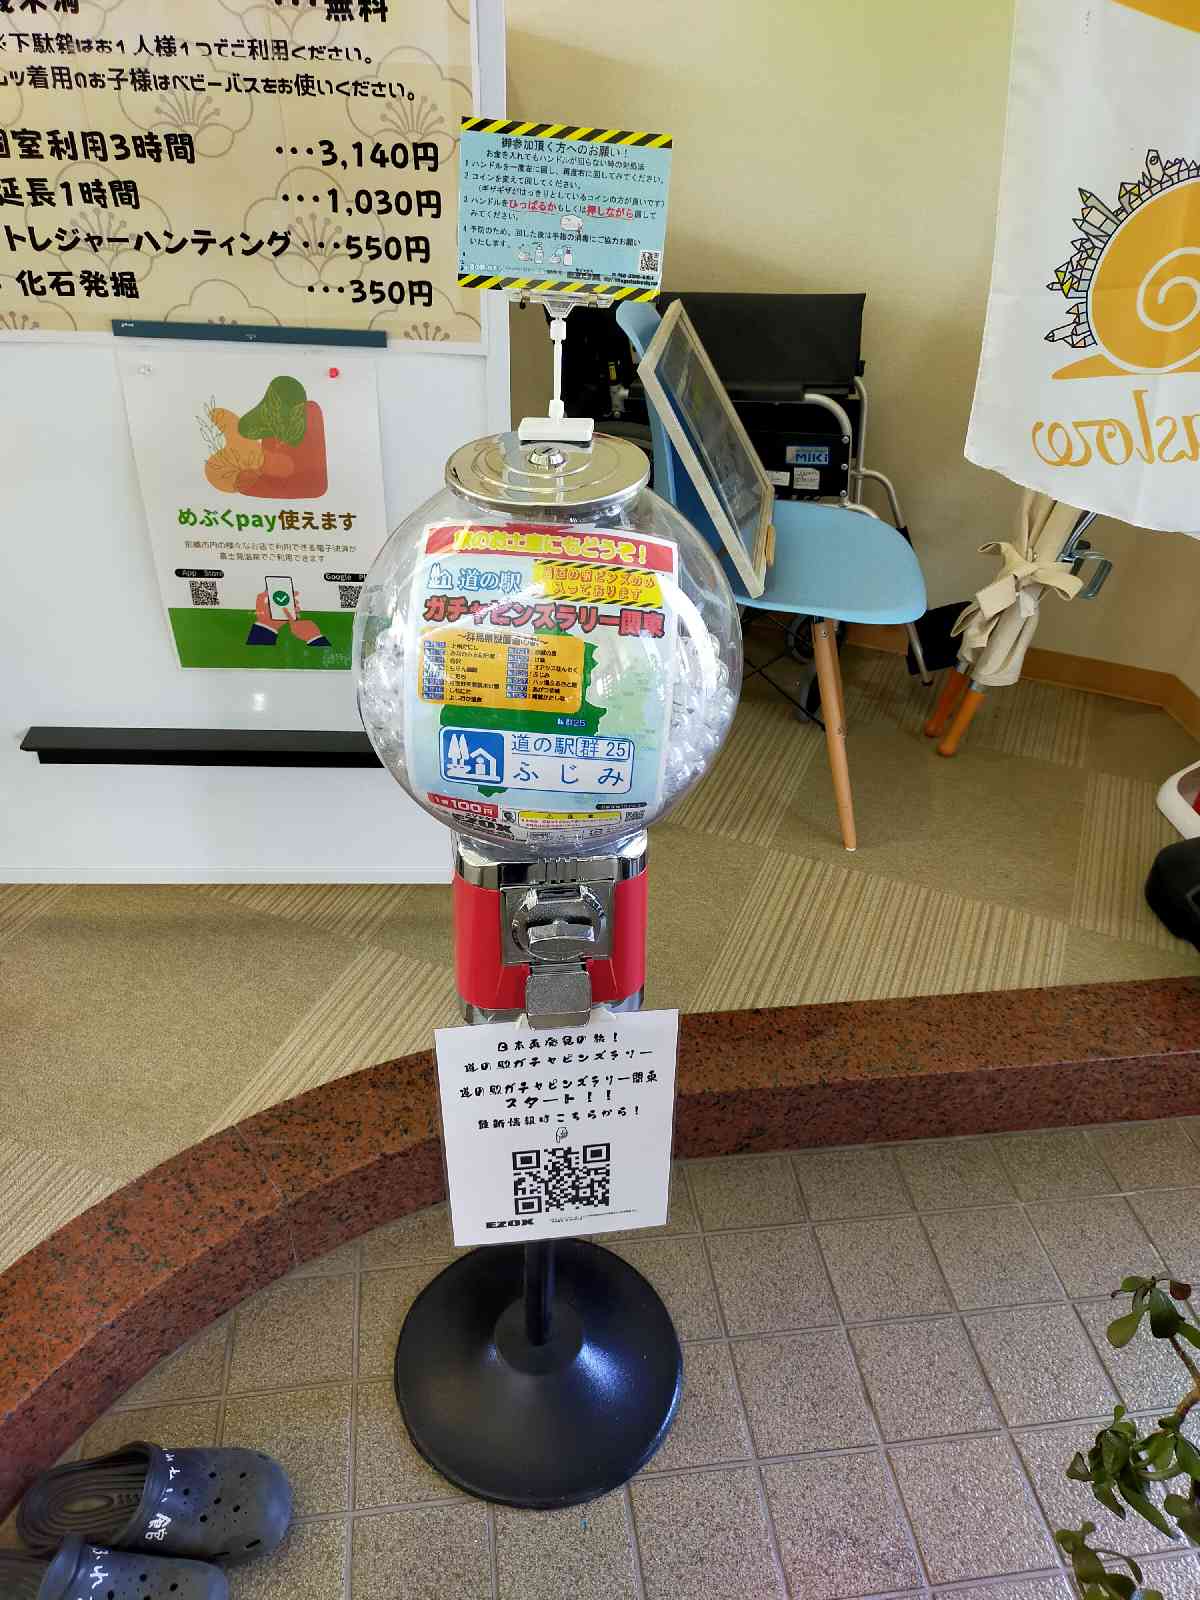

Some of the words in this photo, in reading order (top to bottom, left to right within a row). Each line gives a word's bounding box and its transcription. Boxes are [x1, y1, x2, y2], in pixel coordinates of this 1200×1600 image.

[16, 270, 139, 298] 化石発掘
[178, 507, 357, 532] めぶくpay使えます
[456, 567, 523, 594] 道の駅
[511, 734, 575, 756] 道の駅
[512, 761, 624, 787] ふじみ
